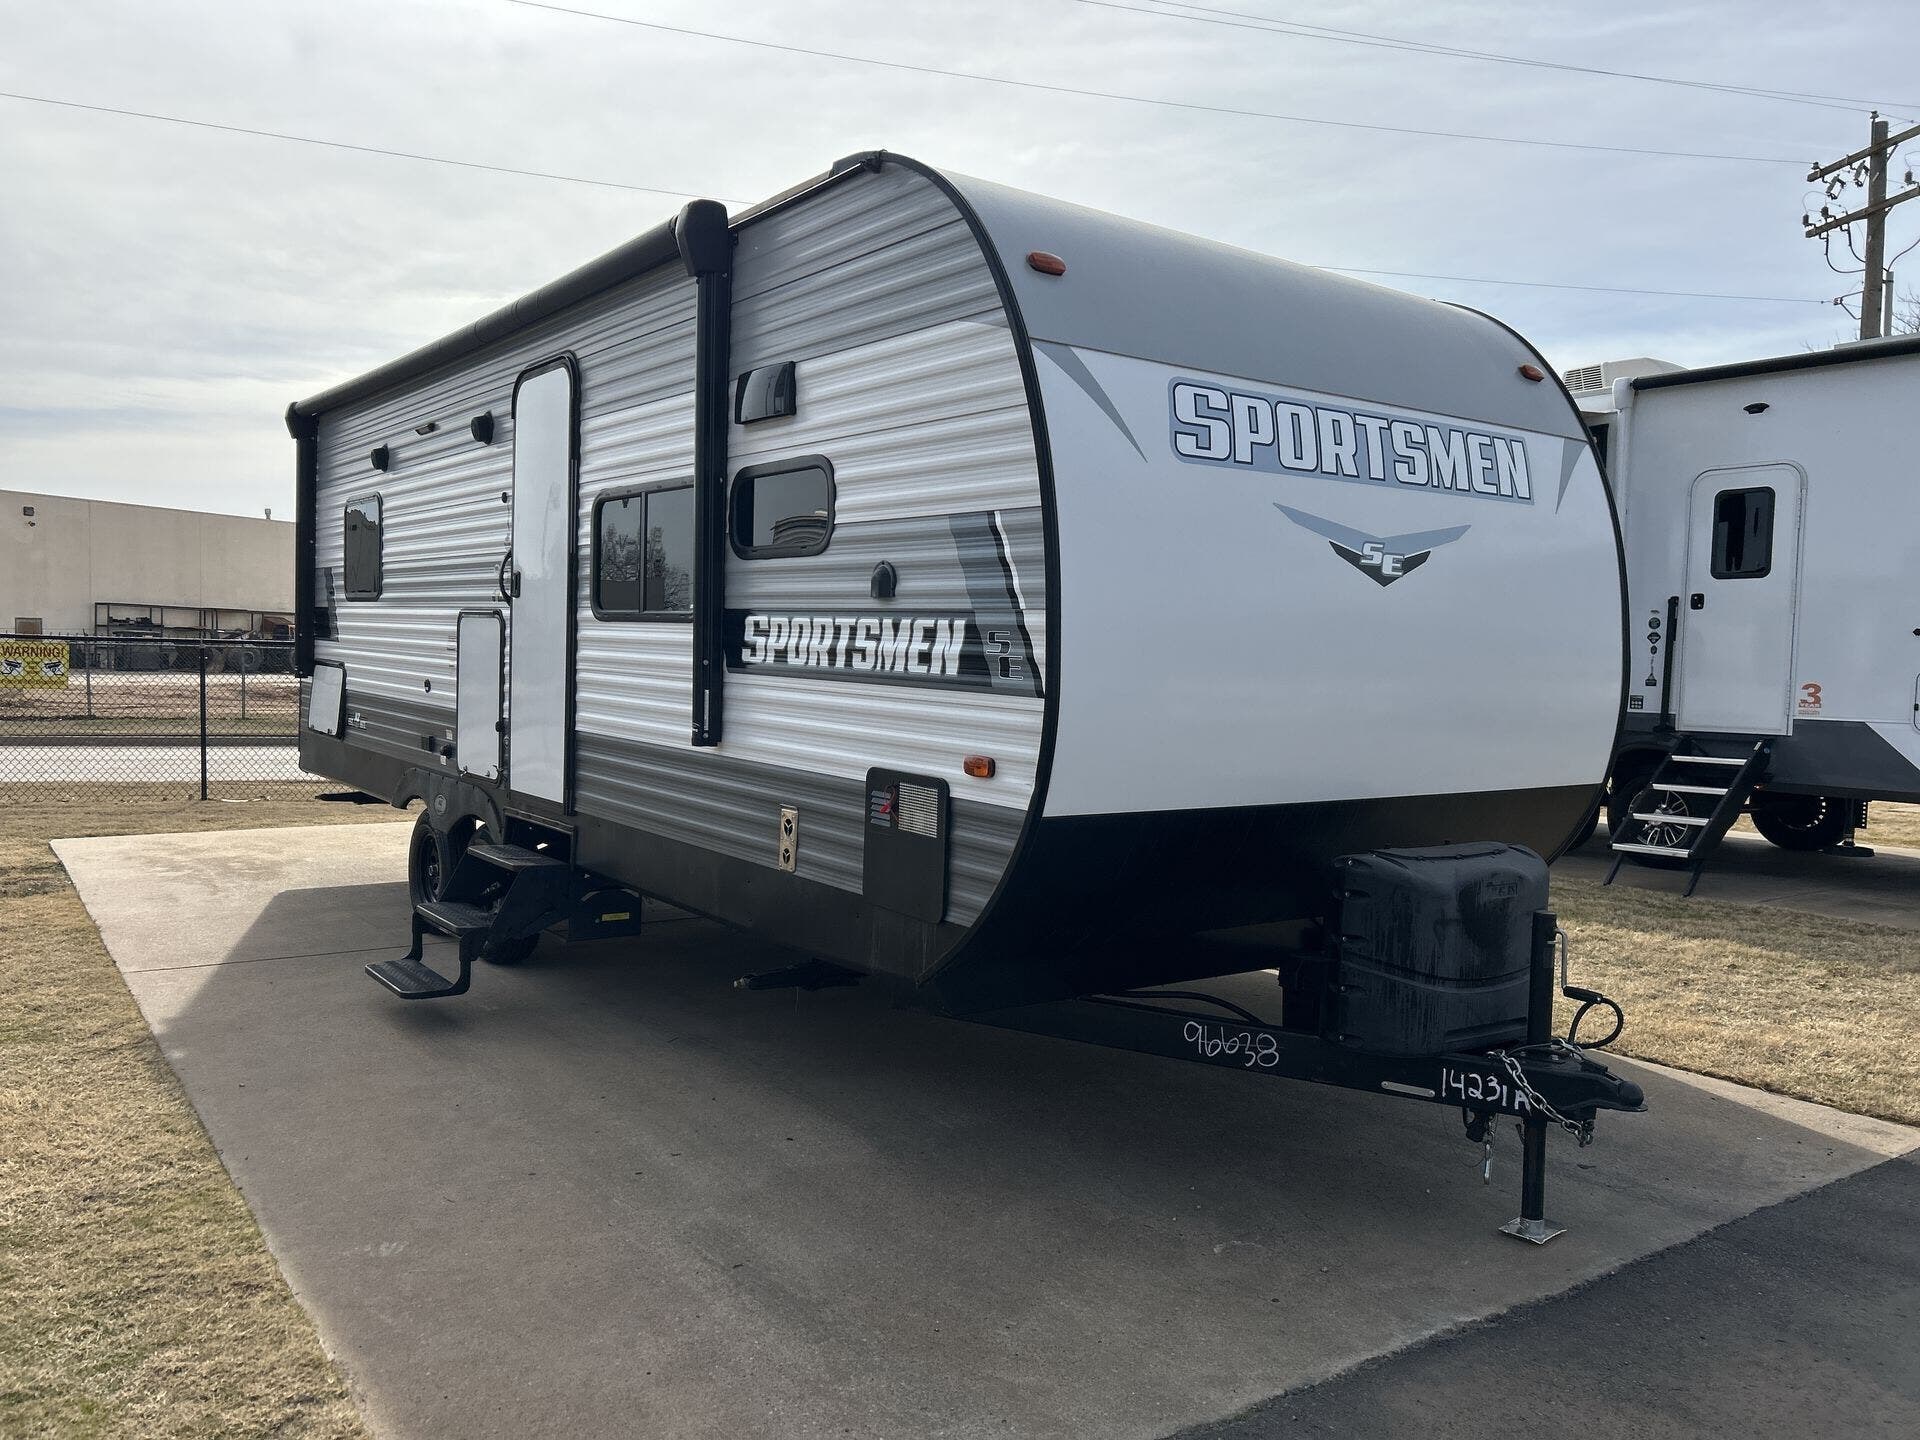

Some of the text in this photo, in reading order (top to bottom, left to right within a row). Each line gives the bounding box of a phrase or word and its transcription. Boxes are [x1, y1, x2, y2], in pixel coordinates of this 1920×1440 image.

[1172, 381, 1532, 501] SPORTSMEN
[1360, 541, 1405, 576] SE
[1, 645, 65, 658] WARNING!
[741, 614, 968, 677] SPORTSMEN
[1801, 683, 1822, 704] 3
